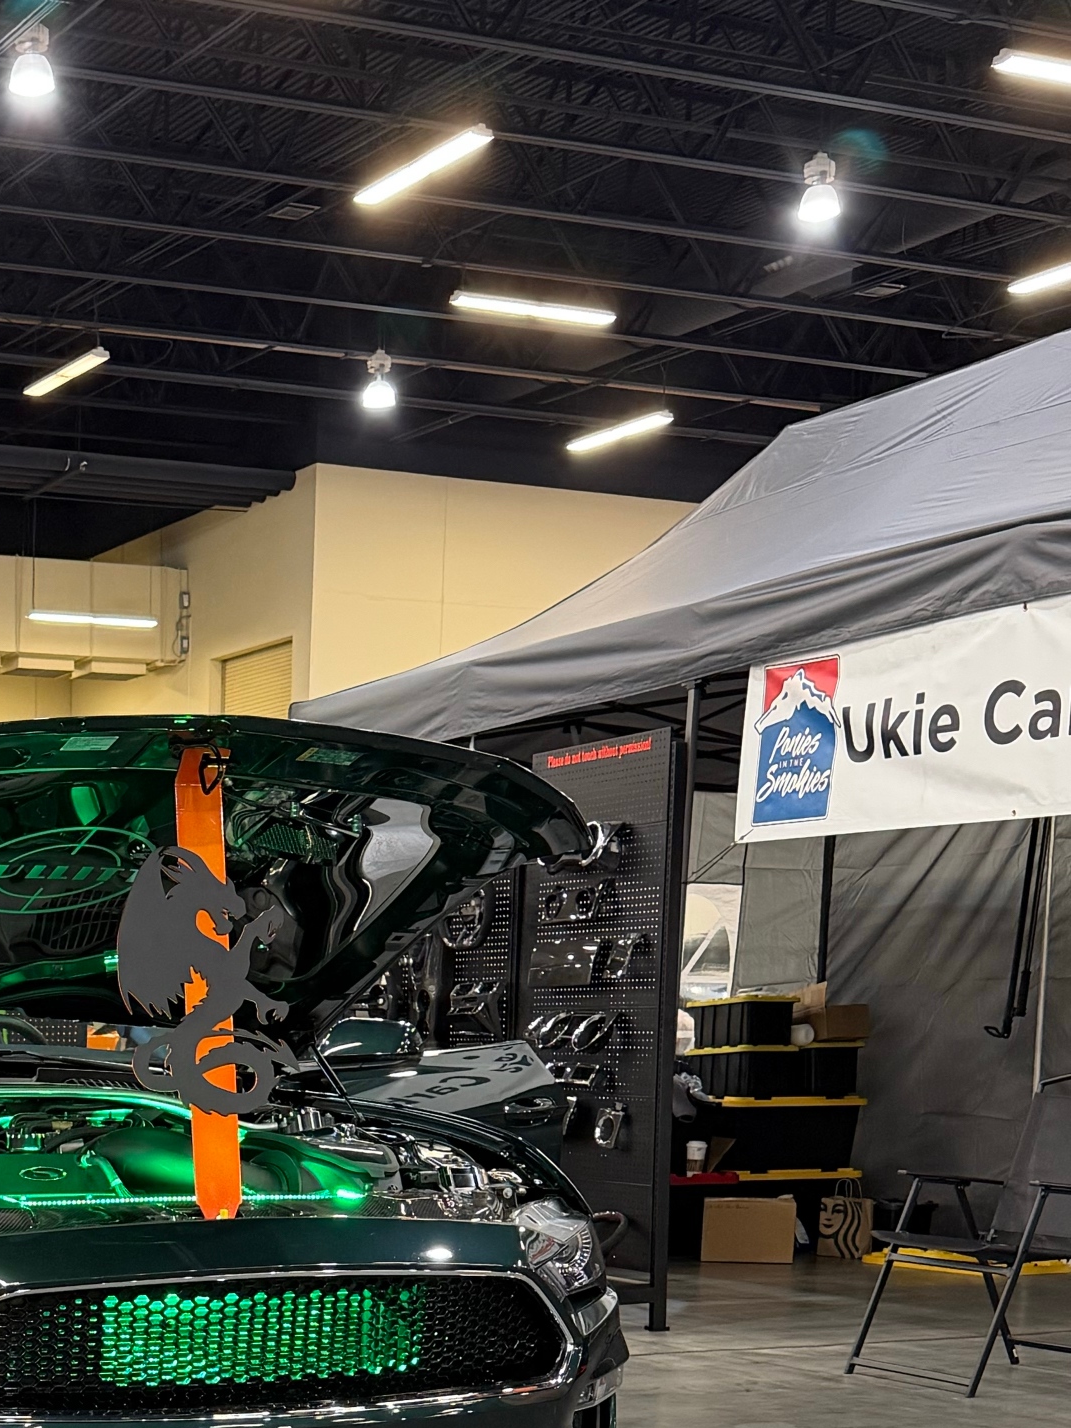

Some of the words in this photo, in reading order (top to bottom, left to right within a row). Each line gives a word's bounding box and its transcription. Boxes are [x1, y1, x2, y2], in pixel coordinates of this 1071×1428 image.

[842, 691, 960, 763] Ukie
[984, 679, 1071, 745] Ca
[548, 756, 563, 768] Please
[564, 753, 571, 766] do
[571, 751, 581, 764] not
[582, 747, 597, 762] touch
[598, 744, 618, 758] without
[619, 737, 651, 758] permission!
[769, 727, 821, 764] Ponies
[779, 760, 787, 769] IN
[789, 758, 804, 767] THE
[756, 759, 831, 803] Smokies
